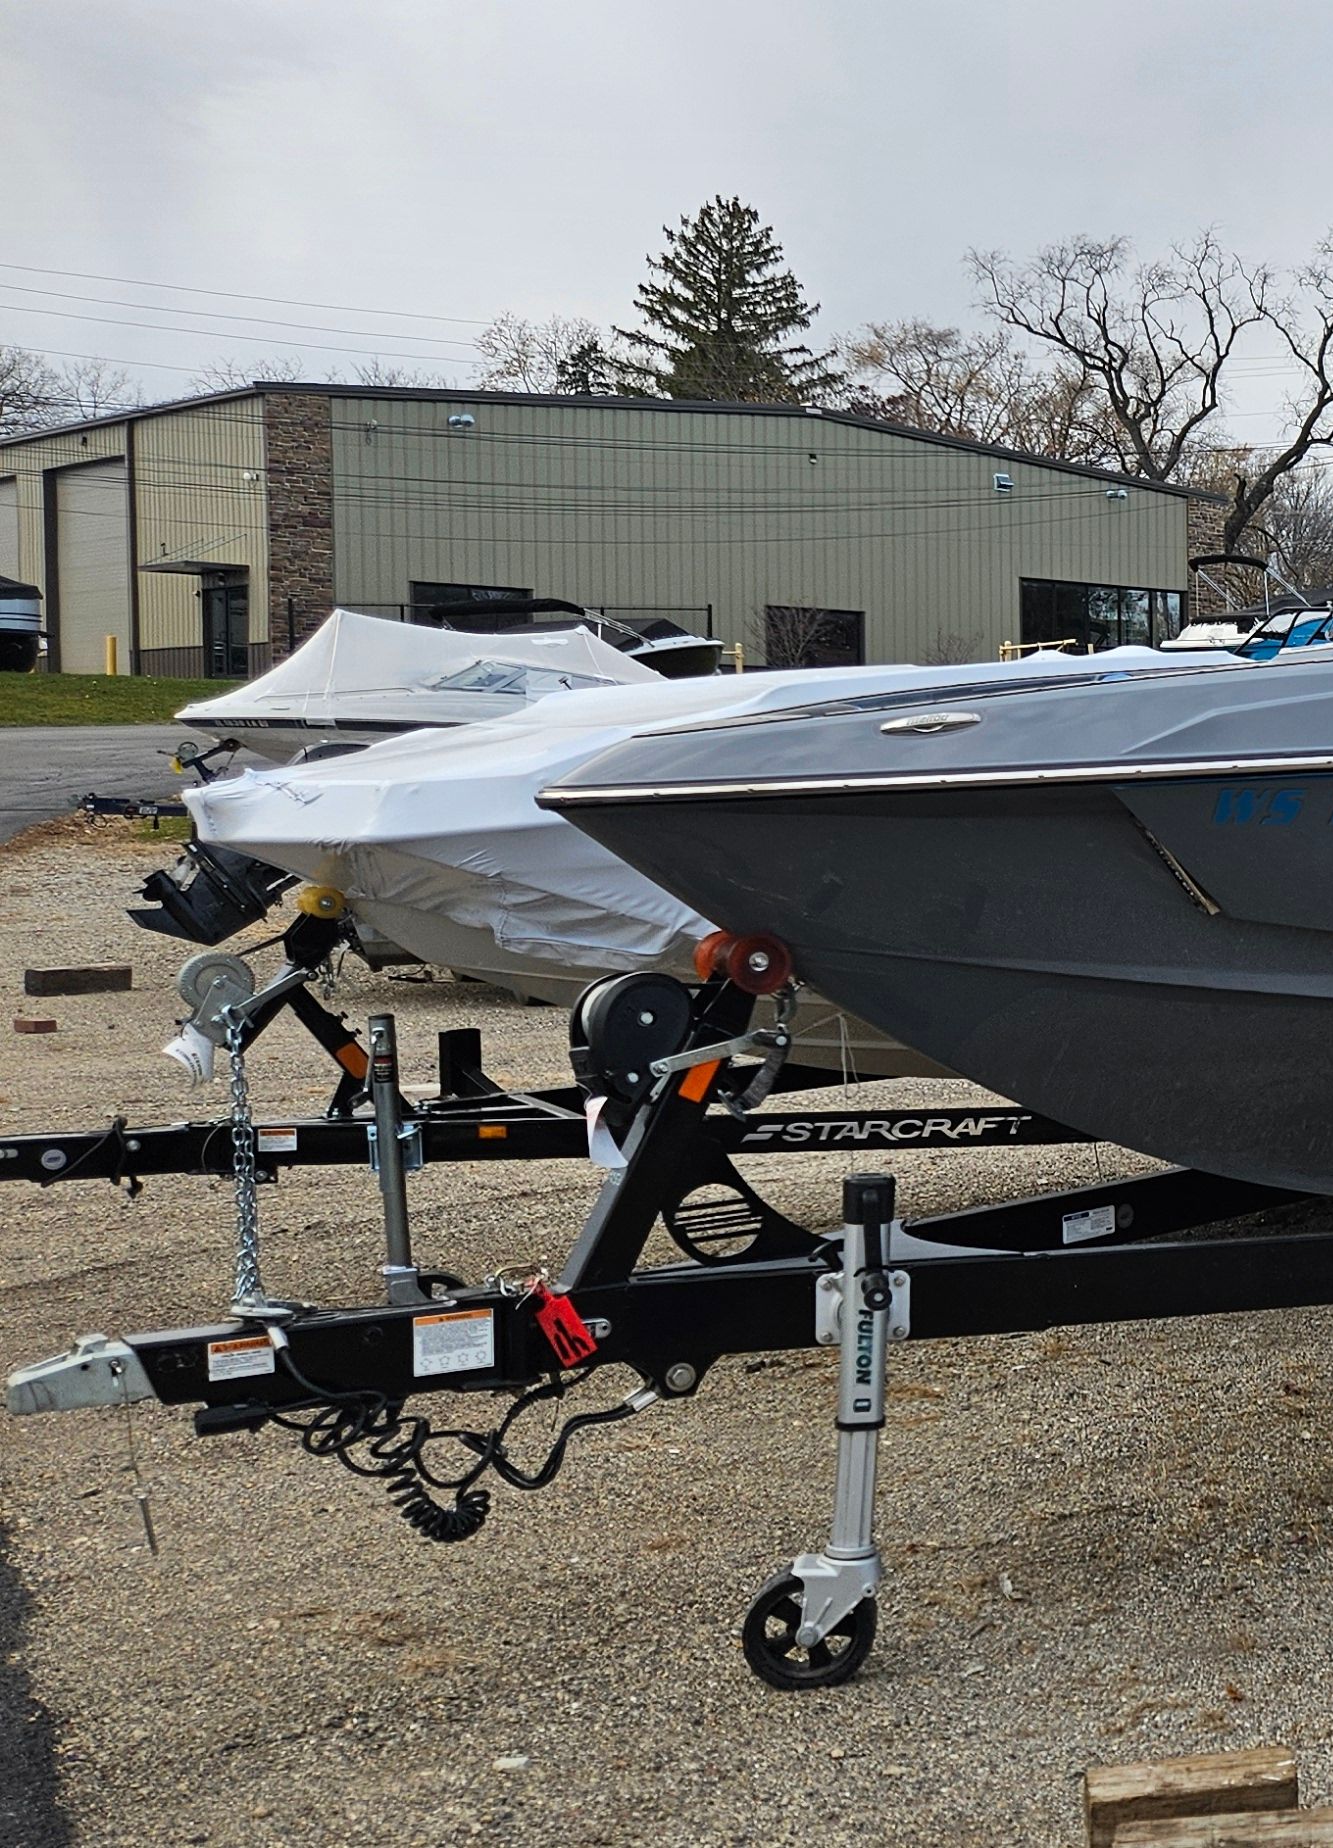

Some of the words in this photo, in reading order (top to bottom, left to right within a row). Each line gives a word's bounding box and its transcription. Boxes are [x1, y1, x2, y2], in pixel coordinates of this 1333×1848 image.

[1212, 788, 1309, 825] WS
[781, 1115, 1032, 1142] STARCRAFT
[856, 1309, 874, 1385] FULTON
